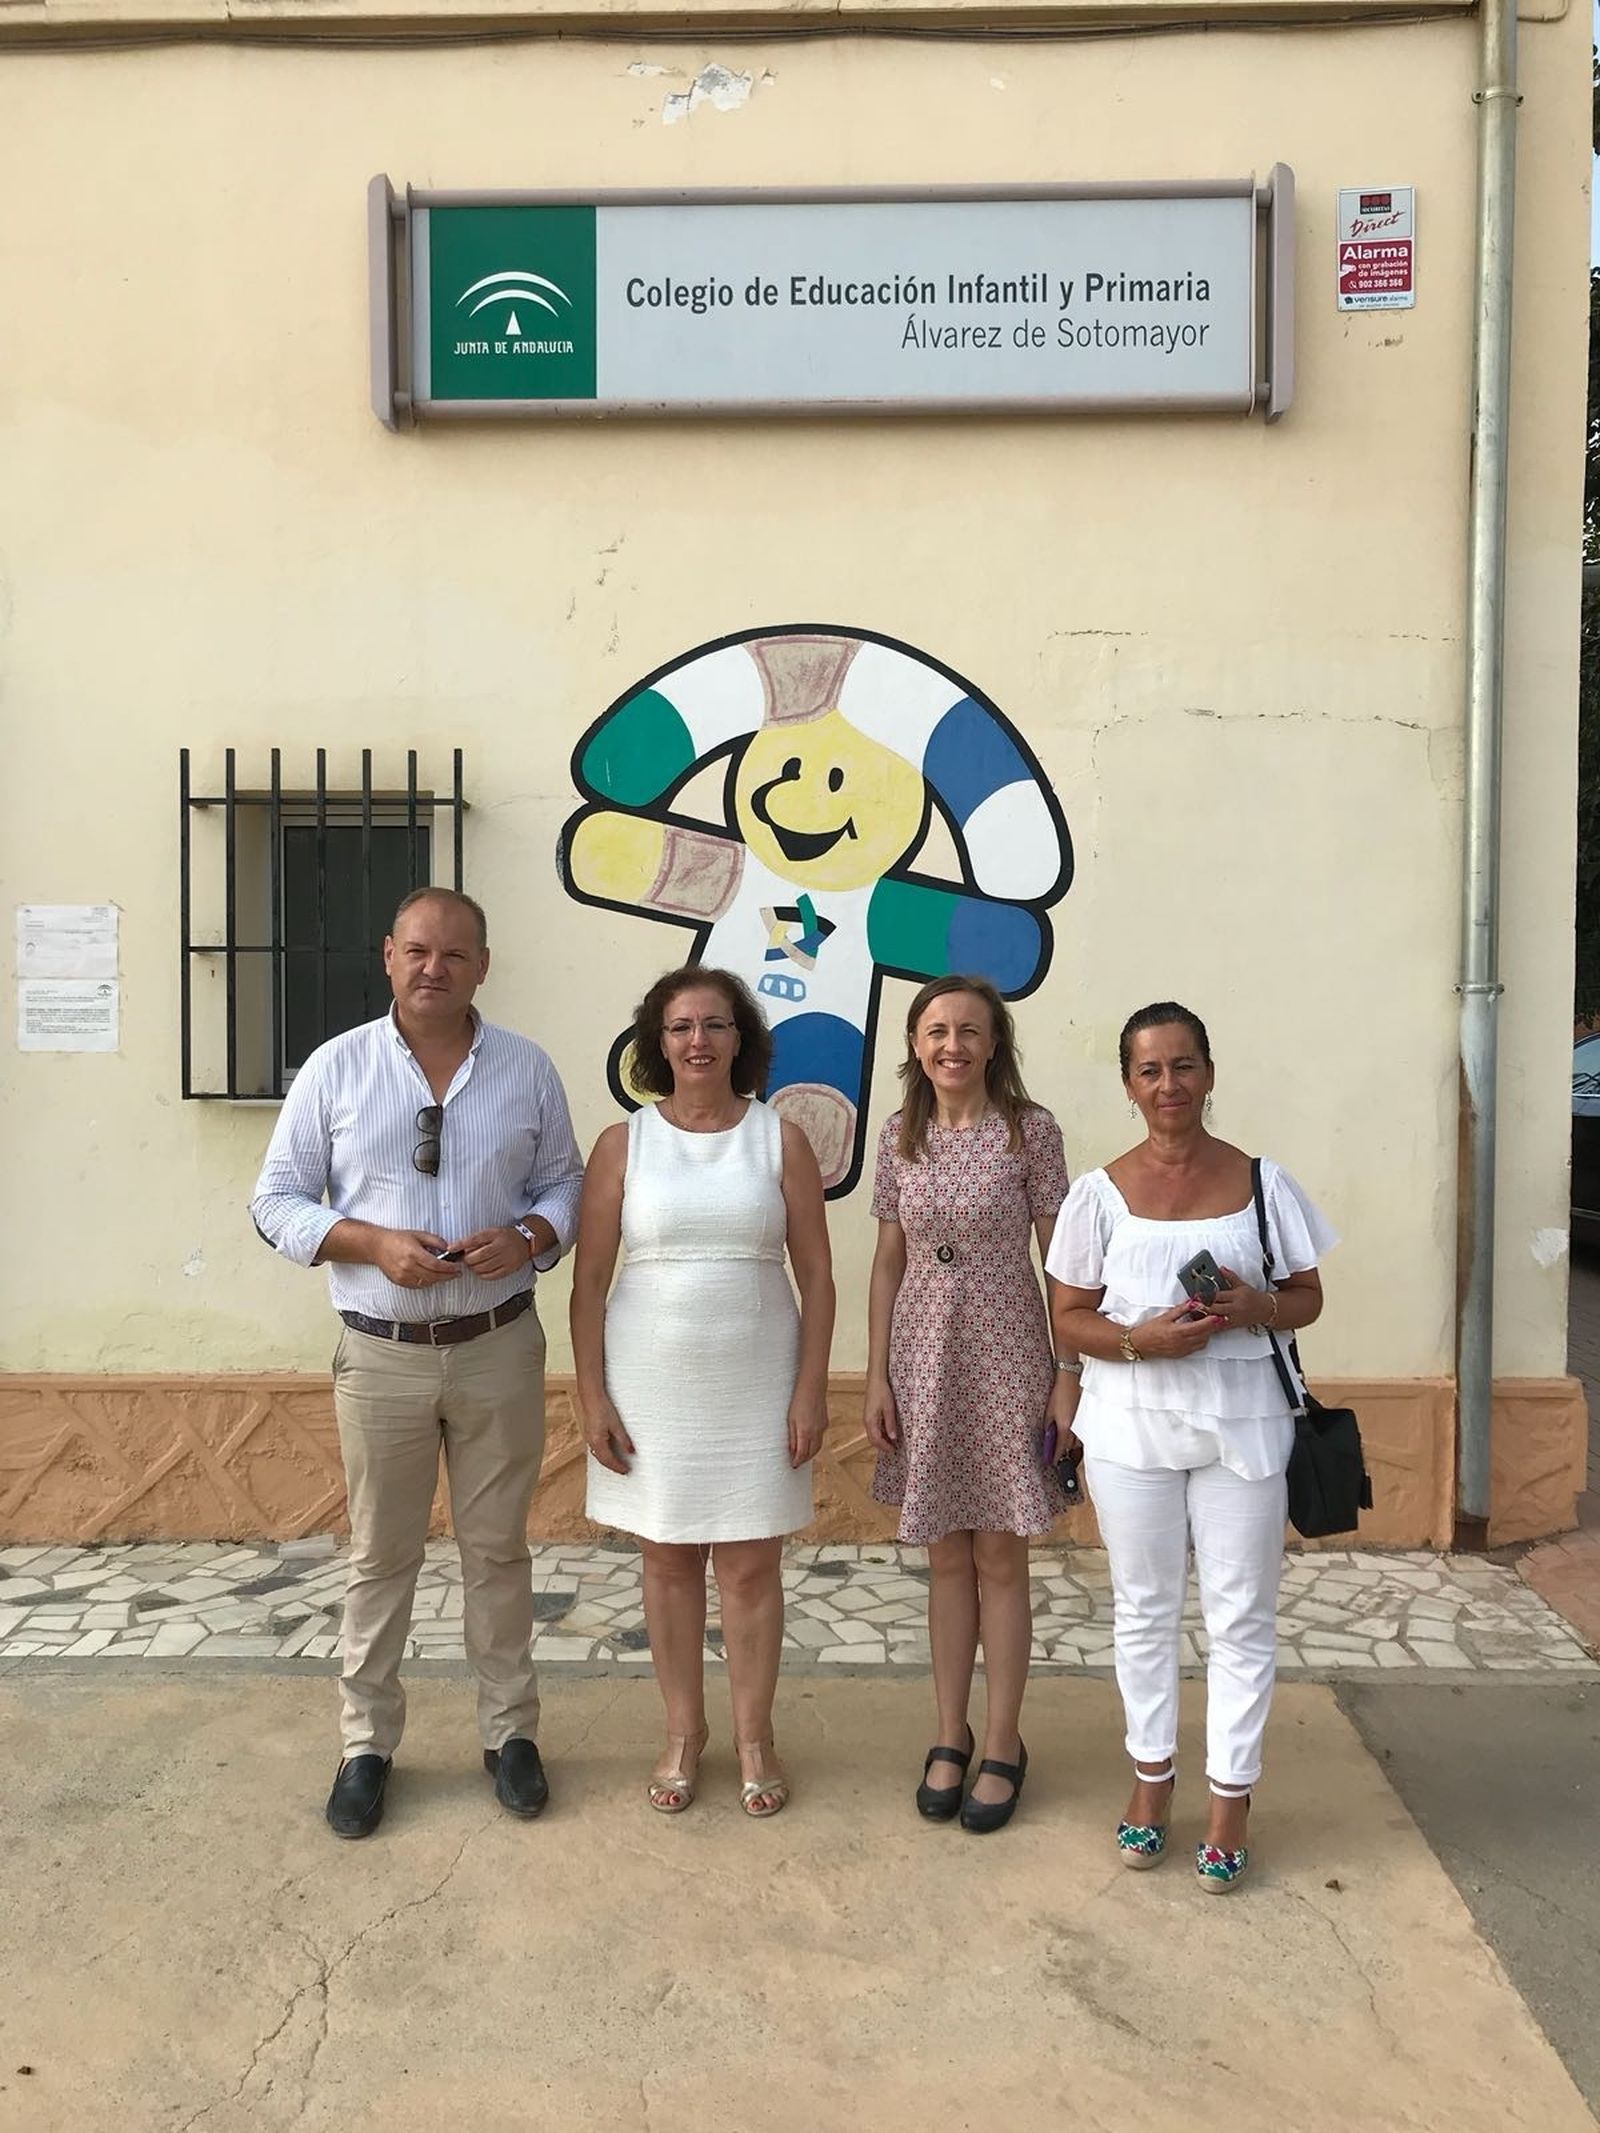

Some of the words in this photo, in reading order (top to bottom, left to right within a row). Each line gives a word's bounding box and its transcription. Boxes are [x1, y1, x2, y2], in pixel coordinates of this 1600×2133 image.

[1350, 211, 1406, 237] Direct
[1343, 245, 1408, 260] Alarma
[1372, 261, 1409, 269] grabación
[1370, 269, 1408, 278] imágenes
[1358, 280, 1373, 289] 902
[626, 277, 733, 315] Colegio
[745, 276, 779, 306] de
[790, 274, 936, 306] Educación
[948, 273, 1047, 304] Infantil
[1059, 281, 1074, 310] y
[1086, 271, 1211, 302] Primaria
[901, 313, 1002, 349] Álvarez
[1013, 318, 1046, 348] de
[1057, 317, 1210, 355] Sotomayor
[454, 342, 489, 355] JUNTA
[495, 342, 508, 354] DE
